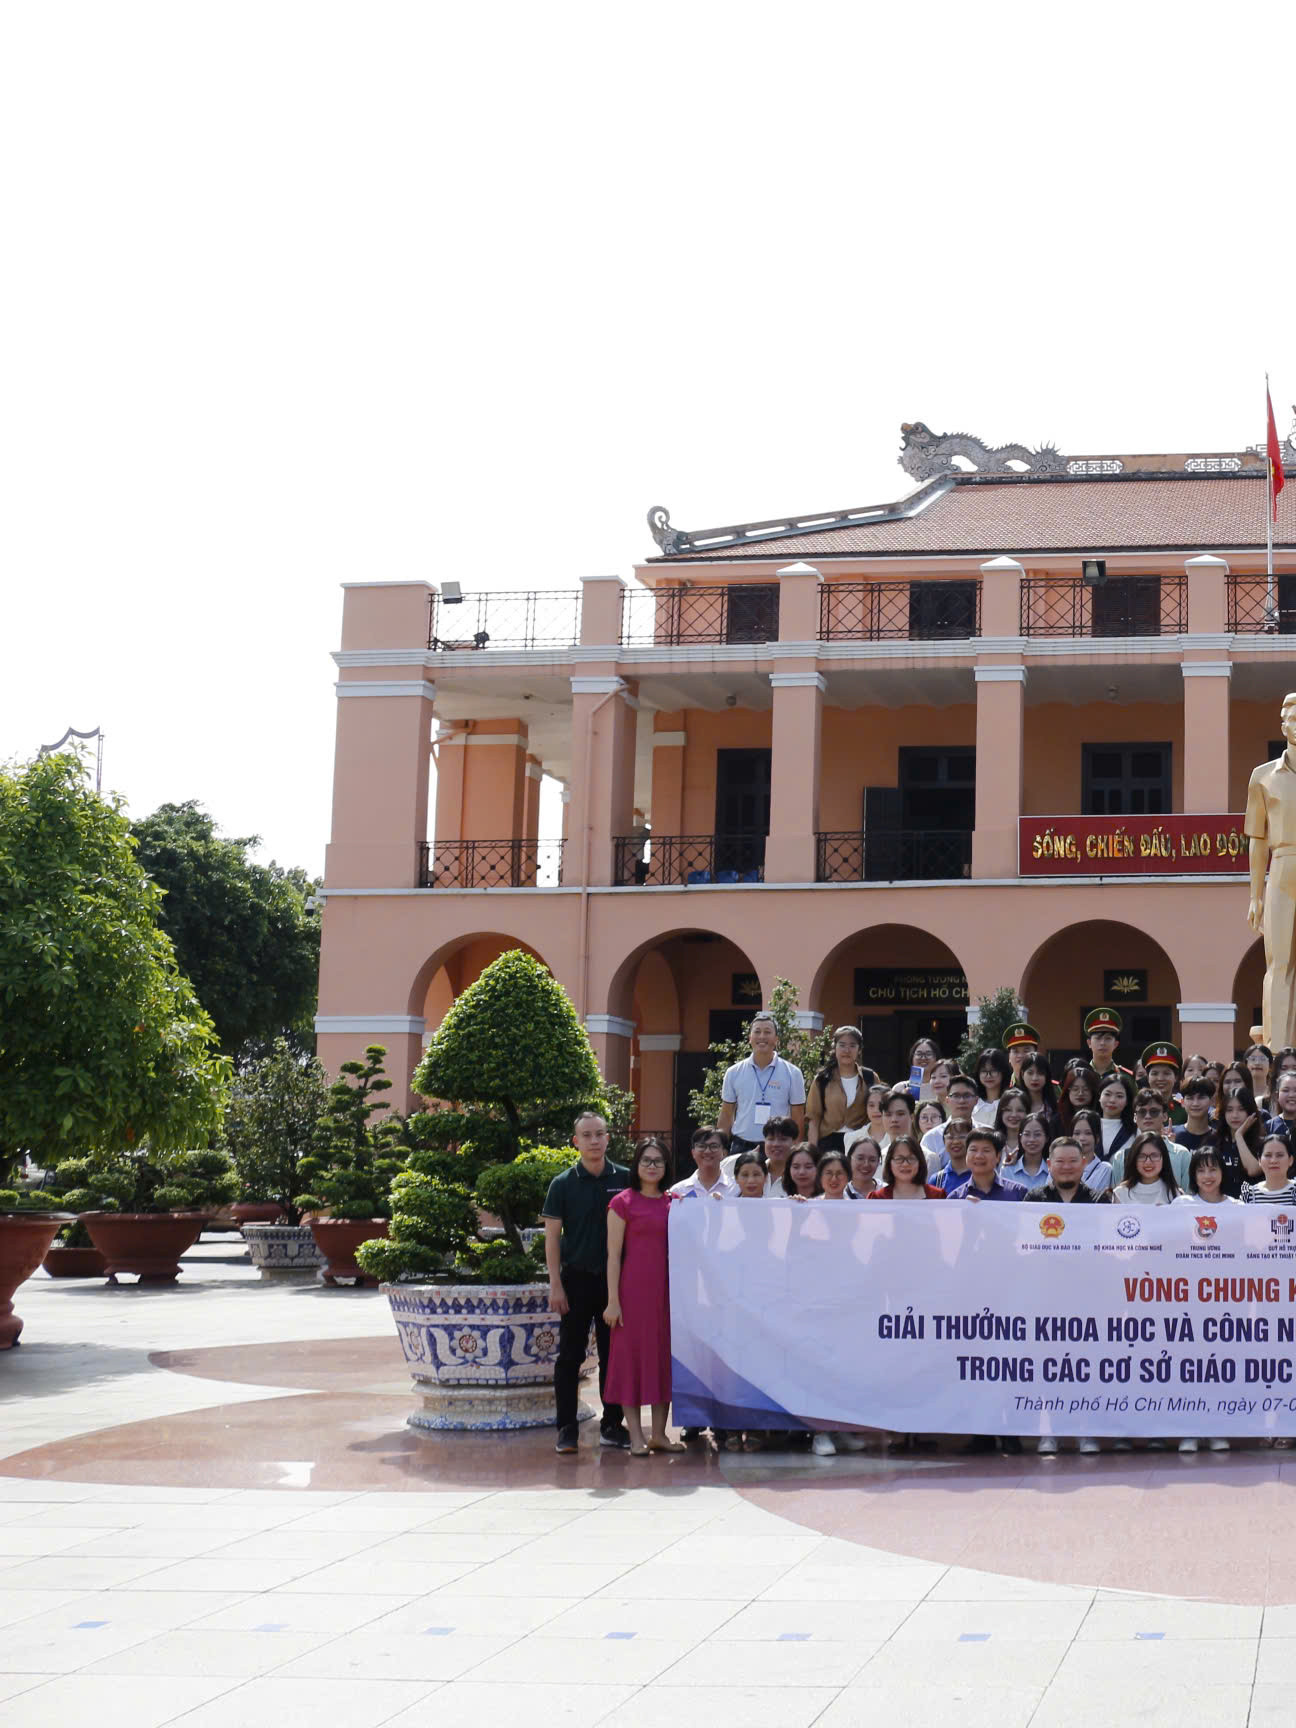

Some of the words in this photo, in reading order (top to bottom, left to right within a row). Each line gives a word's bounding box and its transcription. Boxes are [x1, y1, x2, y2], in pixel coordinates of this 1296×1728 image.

[1032, 826, 1081, 863] SỐNG,
[1086, 826, 1135, 858] CHIẾN
[1140, 826, 1176, 862] ĐẤU,
[1180, 833, 1212, 858] LAO
[1216, 827, 1250, 862] ĐỘN
[952, 987, 969, 998] CH
[1124, 1271, 1189, 1302] VÒNG
[1197, 1278, 1280, 1302] CHUNG
[878, 1306, 925, 1339] GIẢI
[932, 1307, 1027, 1342] THƯỞNG
[1034, 1316, 1100, 1342] KHOA
[1107, 1317, 1156, 1348] HỌC
[1164, 1312, 1195, 1342] VÀ
[1202, 1312, 1269, 1342] CÔNG
[956, 1356, 1034, 1382] TRONG
[1042, 1353, 1090, 1383] CÁC
[1099, 1356, 1132, 1383] CƠ
[1139, 1350, 1172, 1383] SỞ
[1180, 1353, 1236, 1383] GIÁO
[1244, 1358, 1293, 1389] DỤC
[1014, 1396, 1065, 1412] Thành
[1069, 1395, 1102, 1414] phố
[1105, 1395, 1129, 1412] Hồ
[1134, 1396, 1162, 1412] Chí
[1167, 1397, 1211, 1413] Minh,
[1217, 1397, 1257, 1415] ngày
